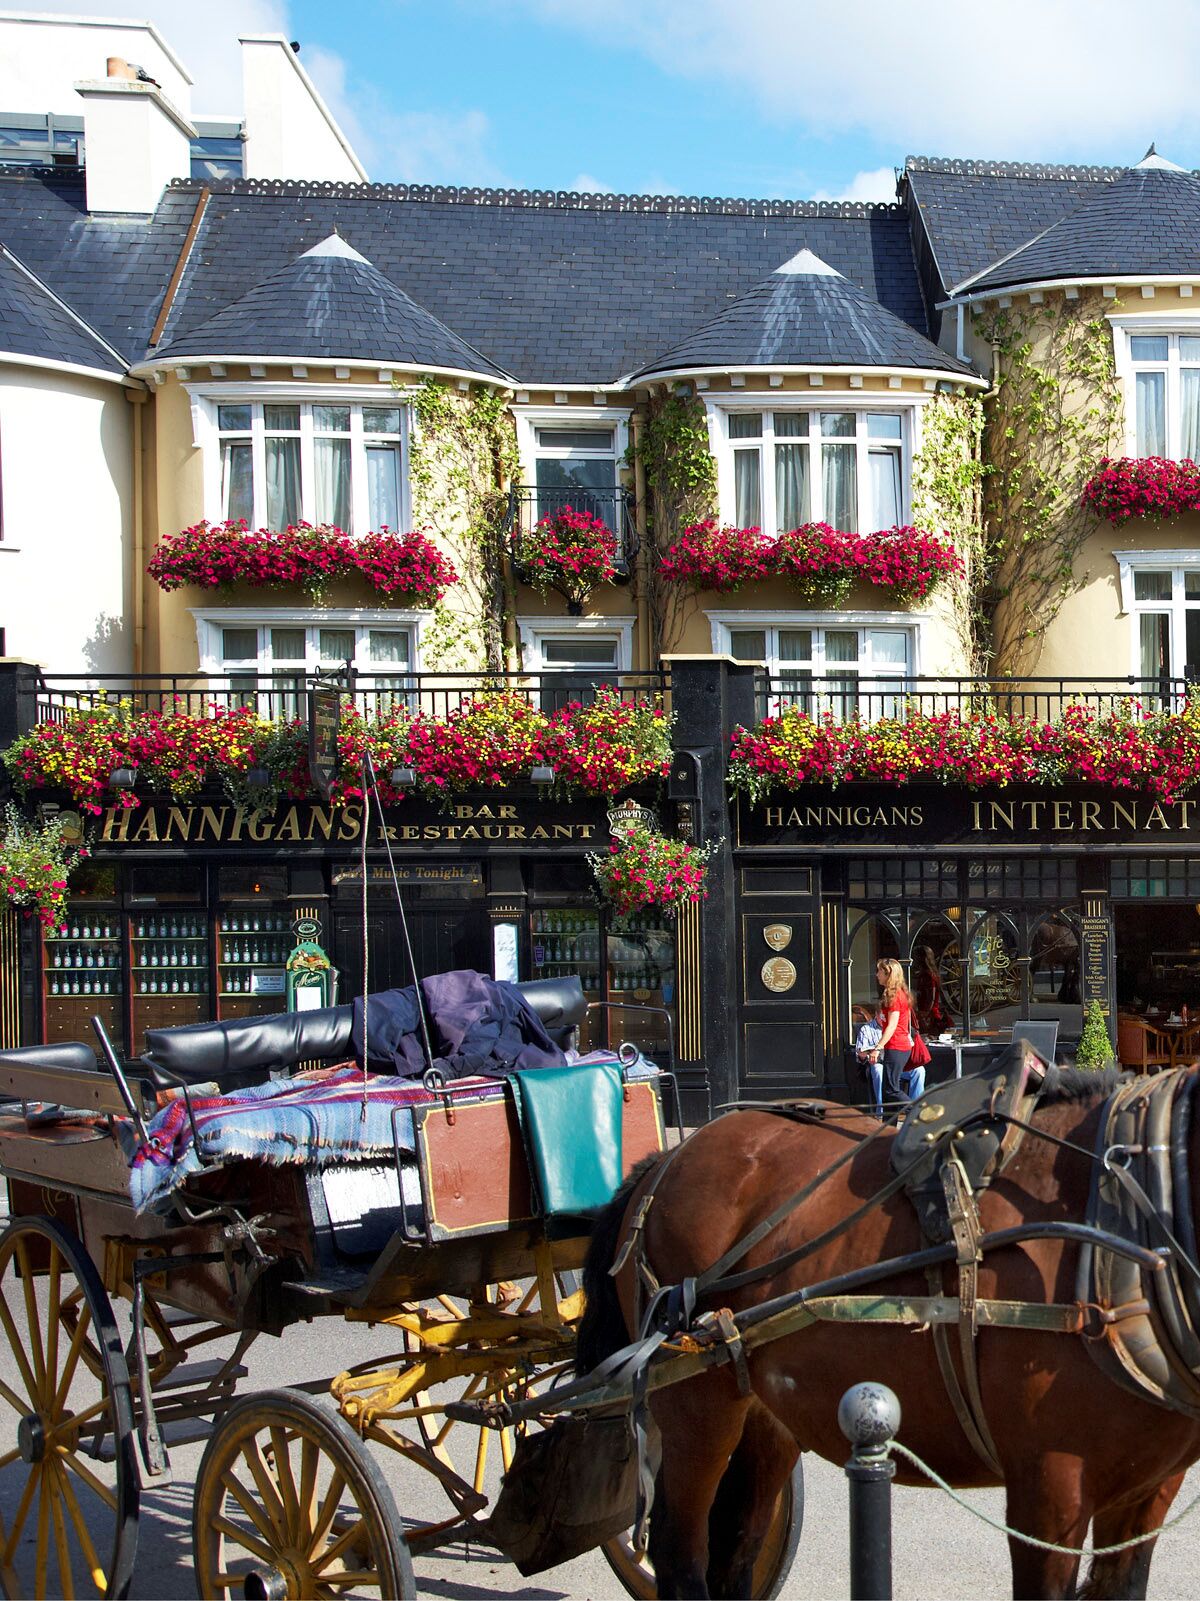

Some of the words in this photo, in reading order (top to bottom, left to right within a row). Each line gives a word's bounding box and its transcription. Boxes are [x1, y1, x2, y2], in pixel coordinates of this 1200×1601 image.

[454, 804, 519, 819] BAR
[765, 806, 923, 827] HANNIGANS
[98, 805, 364, 842] HANNIGANS
[377, 825, 596, 840] RESTAURANT
[372, 867, 410, 879] Music
[415, 866, 465, 880] Tonight
